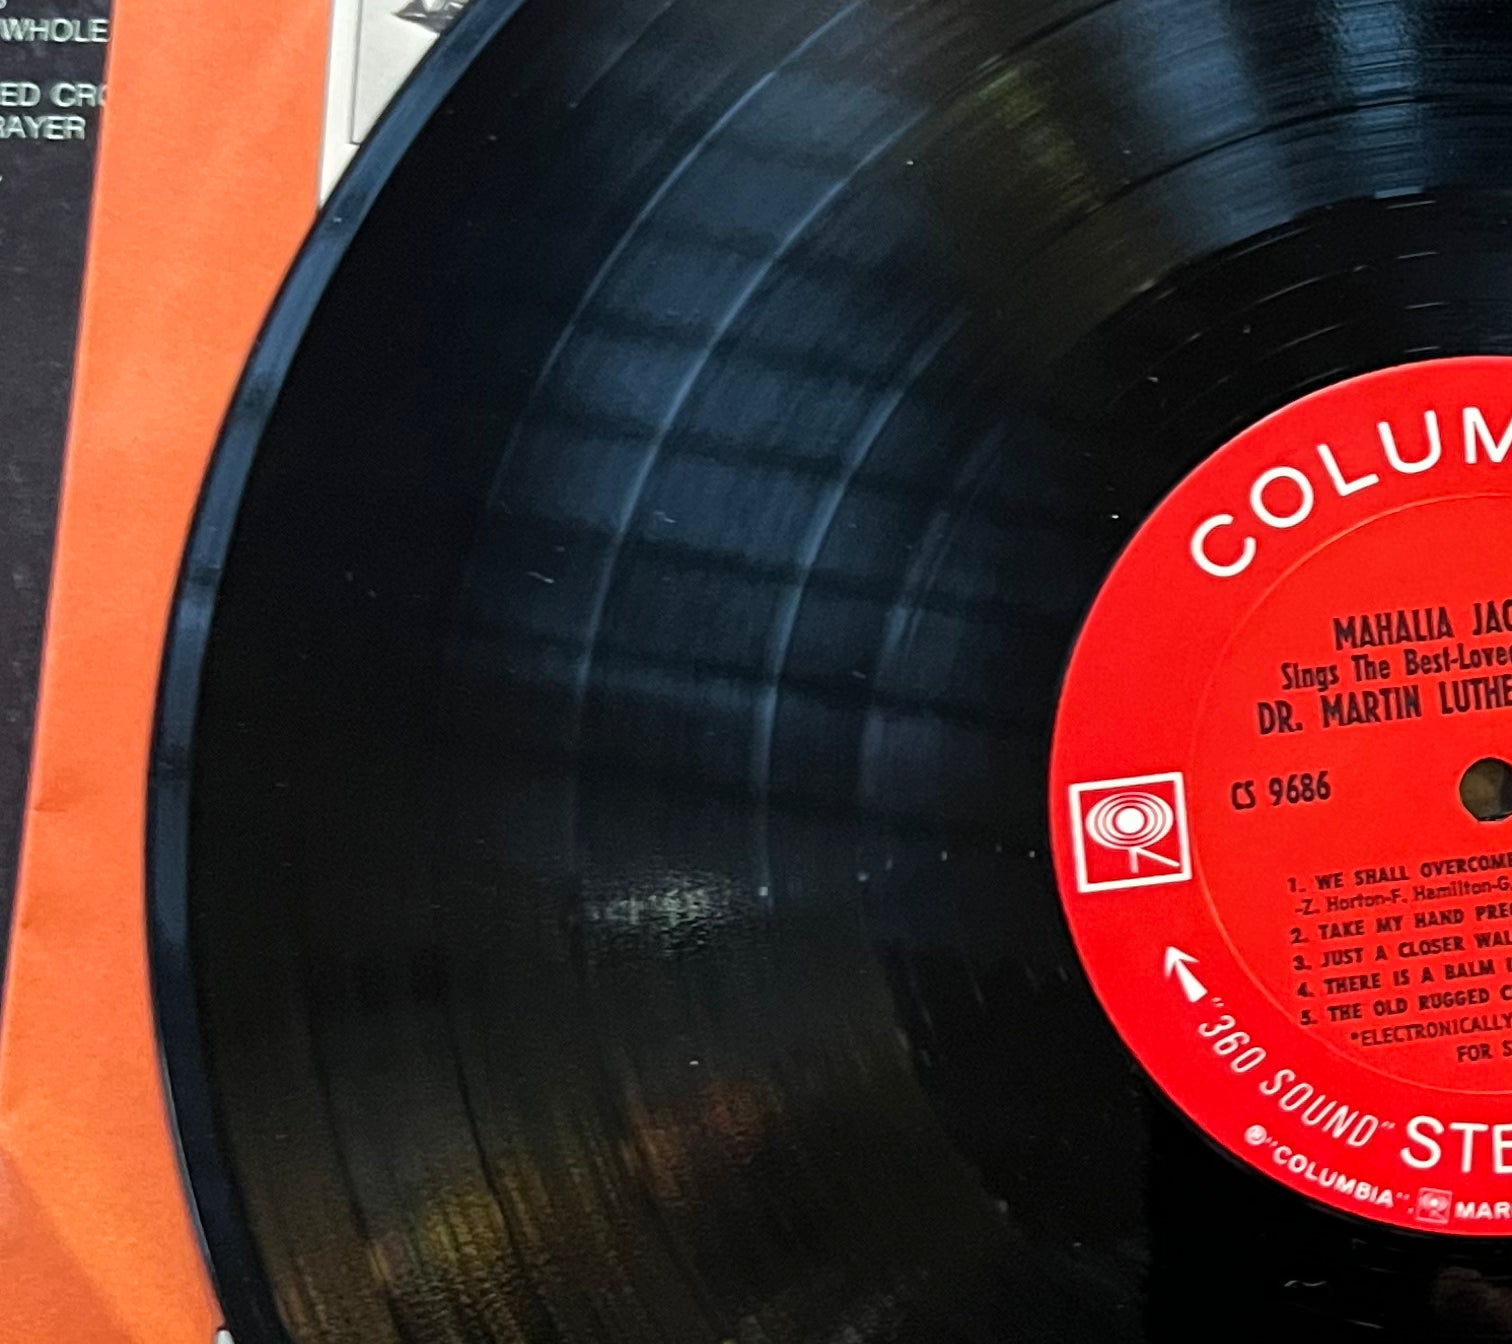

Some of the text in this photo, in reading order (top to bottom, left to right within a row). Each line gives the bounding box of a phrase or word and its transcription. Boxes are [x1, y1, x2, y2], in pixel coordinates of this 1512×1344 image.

[0, 18, 110, 43] WHOLE
[1333, 606, 1455, 651] MAHALIA
[1281, 658, 1340, 693] Sings
[1351, 652, 1391, 682] The
[1256, 699, 1304, 736] DR.
[1320, 684, 1422, 729] MARTIN
[1229, 770, 1332, 811] CS 9686
[1287, 876, 1307, 893] 1.
[1315, 871, 1345, 891] WE
[1354, 865, 1411, 887] SHALL
[1326, 887, 1409, 913] Horton-F.
[1290, 927, 1309, 945] 2.
[1317, 919, 1366, 941] TAKE
[1376, 915, 1404, 934] MY
[1413, 908, 1465, 929] HAND
[1292, 954, 1313, 972] 3.
[1320, 947, 1365, 969] JUST
[1374, 945, 1389, 962] A
[1397, 935, 1466, 959] CLOSER
[1297, 981, 1316, 998] 4.
[1323, 972, 1383, 995] THERE
[1393, 968, 1411, 987] IS
[1420, 966, 1435, 984] A
[1443, 958, 1497, 981] BALM
[1300, 1009, 1319, 1026] 5.
[1327, 1002, 1363, 1023] THE
[1372, 997, 1409, 1017] OLD
[1418, 987, 1491, 1011] RUGGED
[1456, 1042, 1494, 1064] FOR
